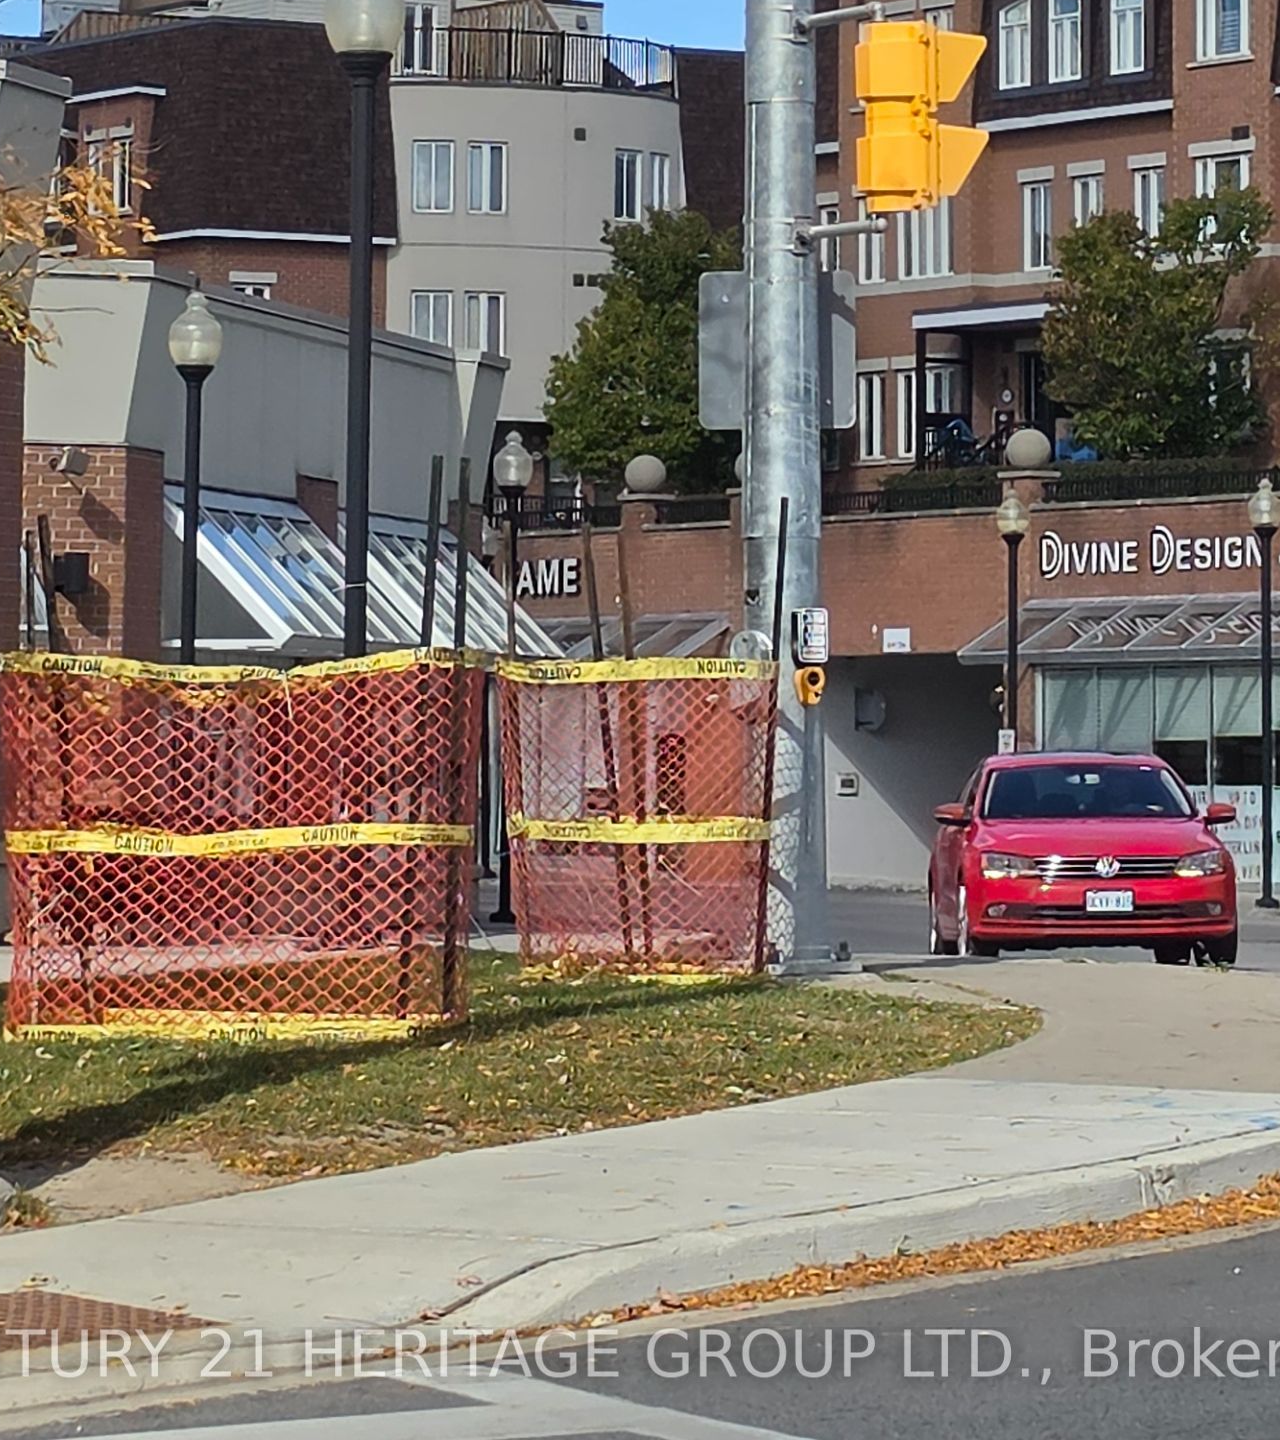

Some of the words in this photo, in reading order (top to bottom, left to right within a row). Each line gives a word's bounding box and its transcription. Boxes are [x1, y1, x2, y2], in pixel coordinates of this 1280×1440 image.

[1040, 530, 1139, 579] DIVINE
[1150, 525, 1262, 575] DESIGN
[503, 558, 581, 596] AME
[41, 658, 103, 673] CAUTION
[114, 835, 173, 852] CAUTION
[301, 826, 358, 842] CAUTION
